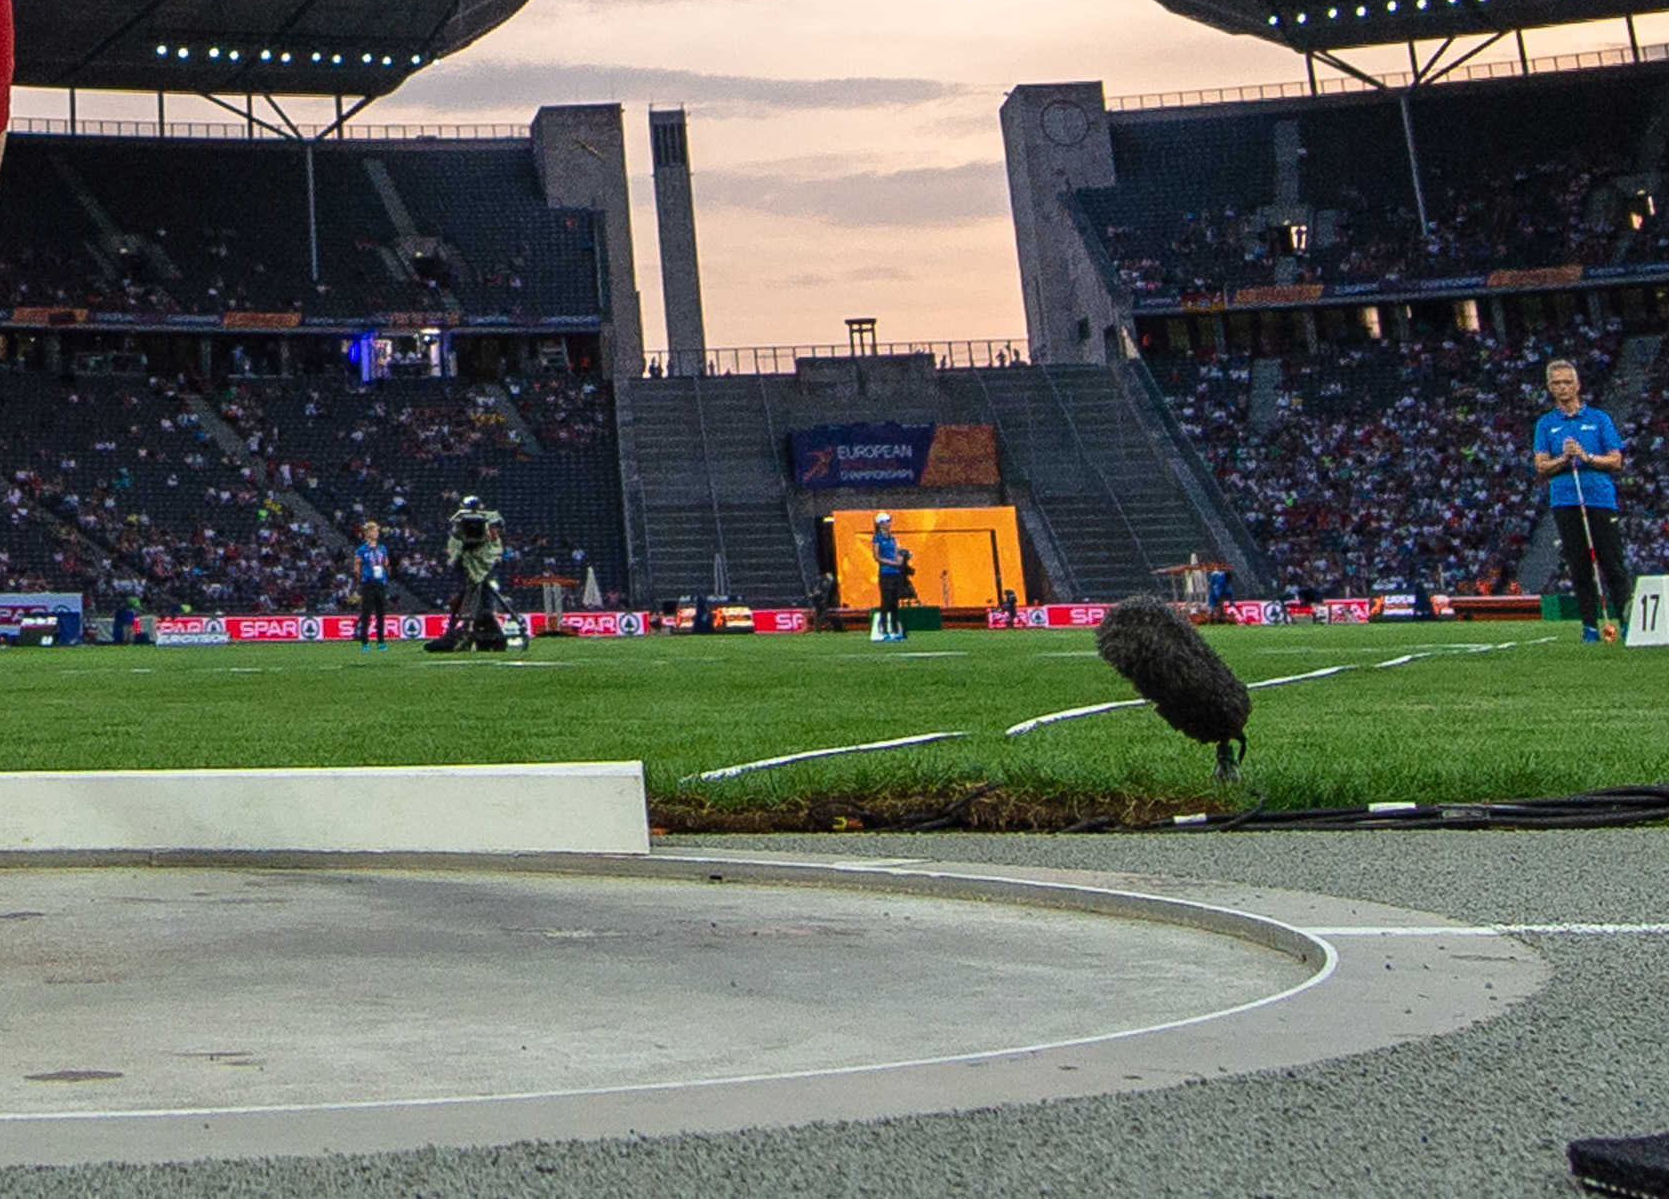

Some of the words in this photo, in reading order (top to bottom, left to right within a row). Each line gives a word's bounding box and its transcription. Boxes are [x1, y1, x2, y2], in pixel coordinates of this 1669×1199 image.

[837, 445, 913, 459] EUROPEAN
[1640, 594, 1660, 631] 17
[240, 620, 298, 638] SPAR
